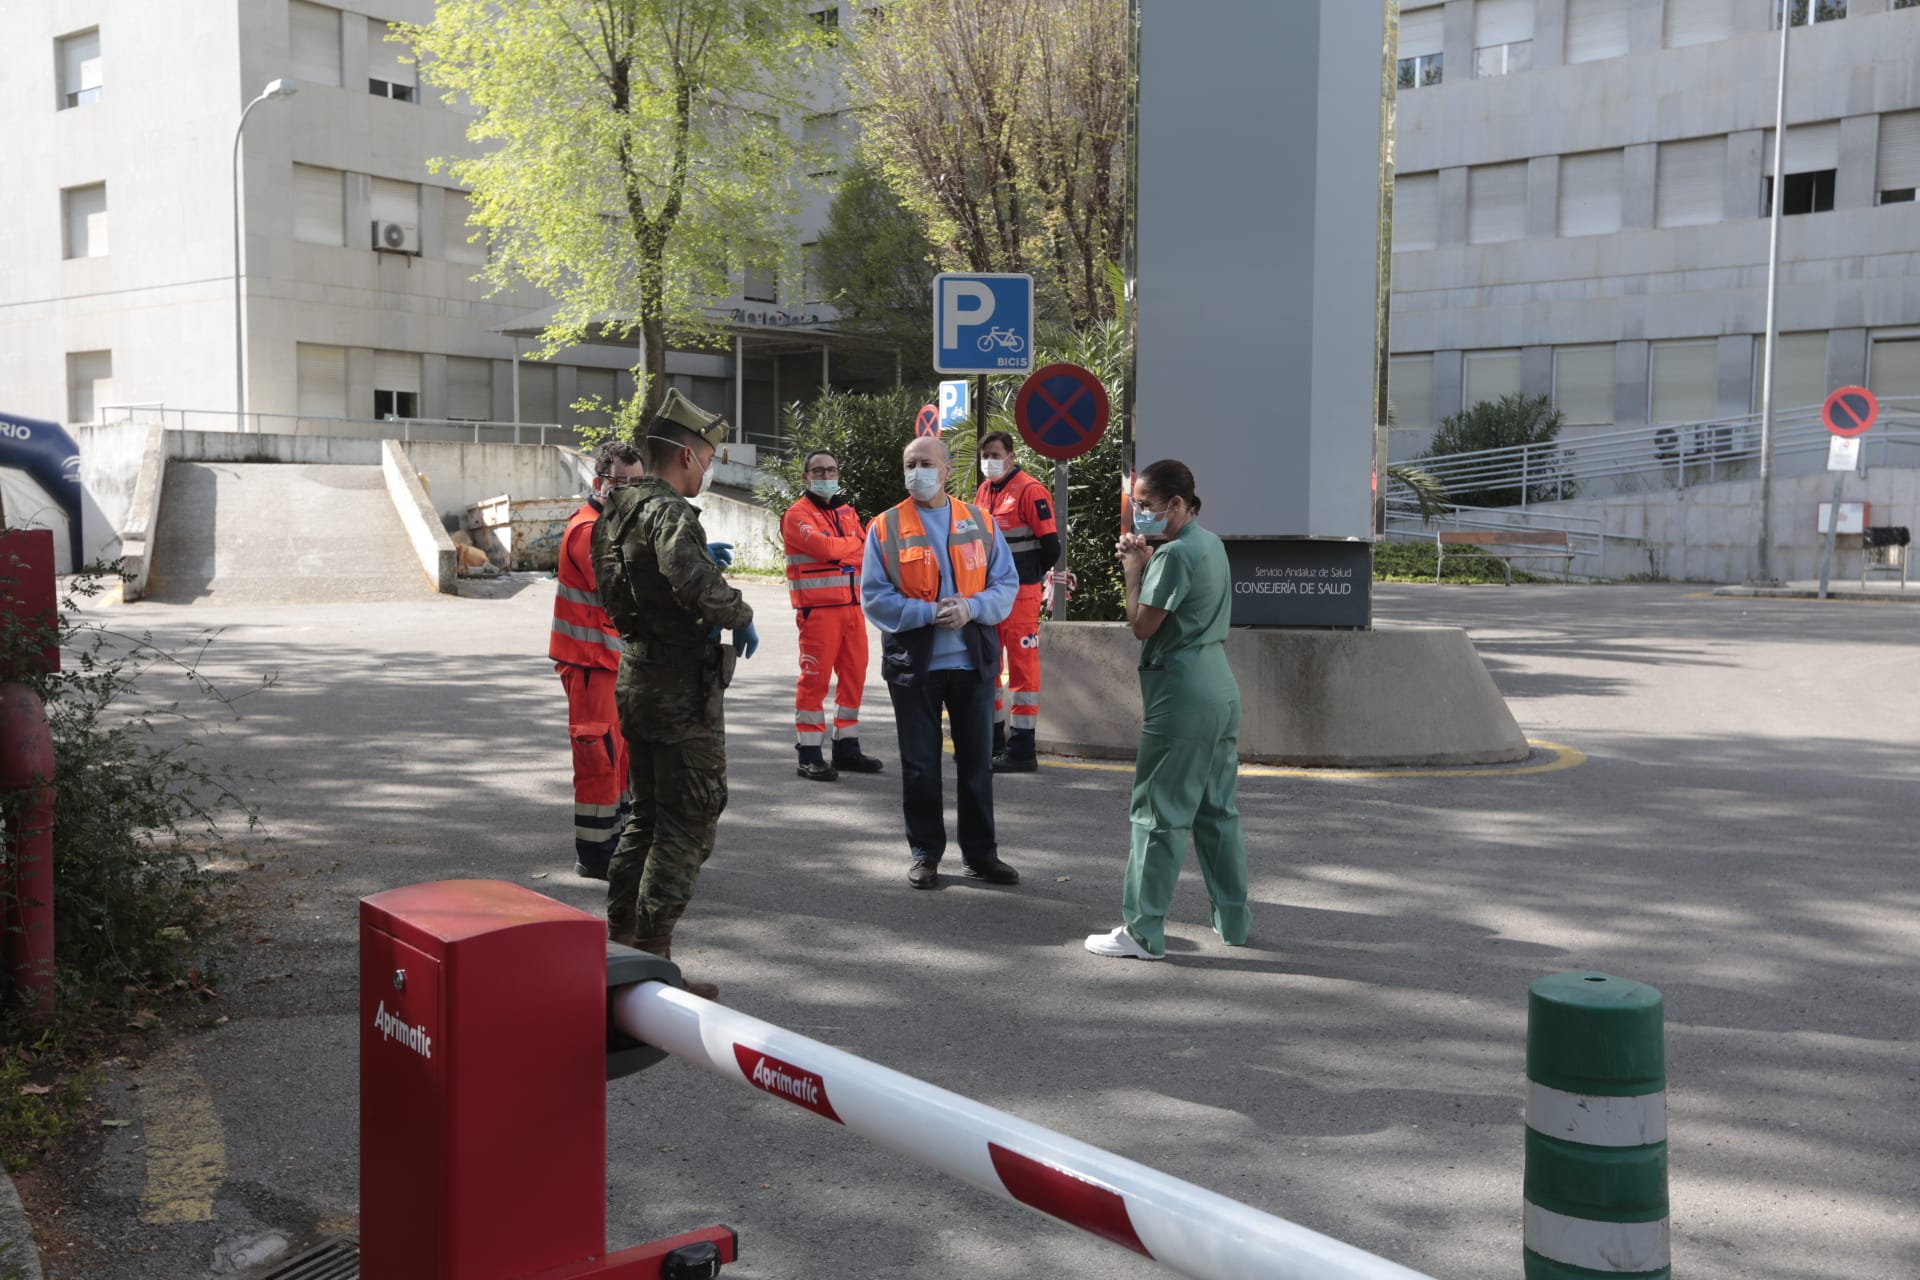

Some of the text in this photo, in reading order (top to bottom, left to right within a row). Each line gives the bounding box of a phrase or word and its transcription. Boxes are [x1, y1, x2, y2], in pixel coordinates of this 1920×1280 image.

[943, 280, 996, 350] P
[997, 357, 1028, 367] BICIS
[942, 384, 957, 419] P
[1234, 579, 1351, 595] CONSEJERÍA DE SALUD
[1255, 566, 1352, 578] Servicio Andaluz de Salud
[374, 999, 431, 1059] Aprimatic
[752, 1056, 818, 1105] Aprimatic
